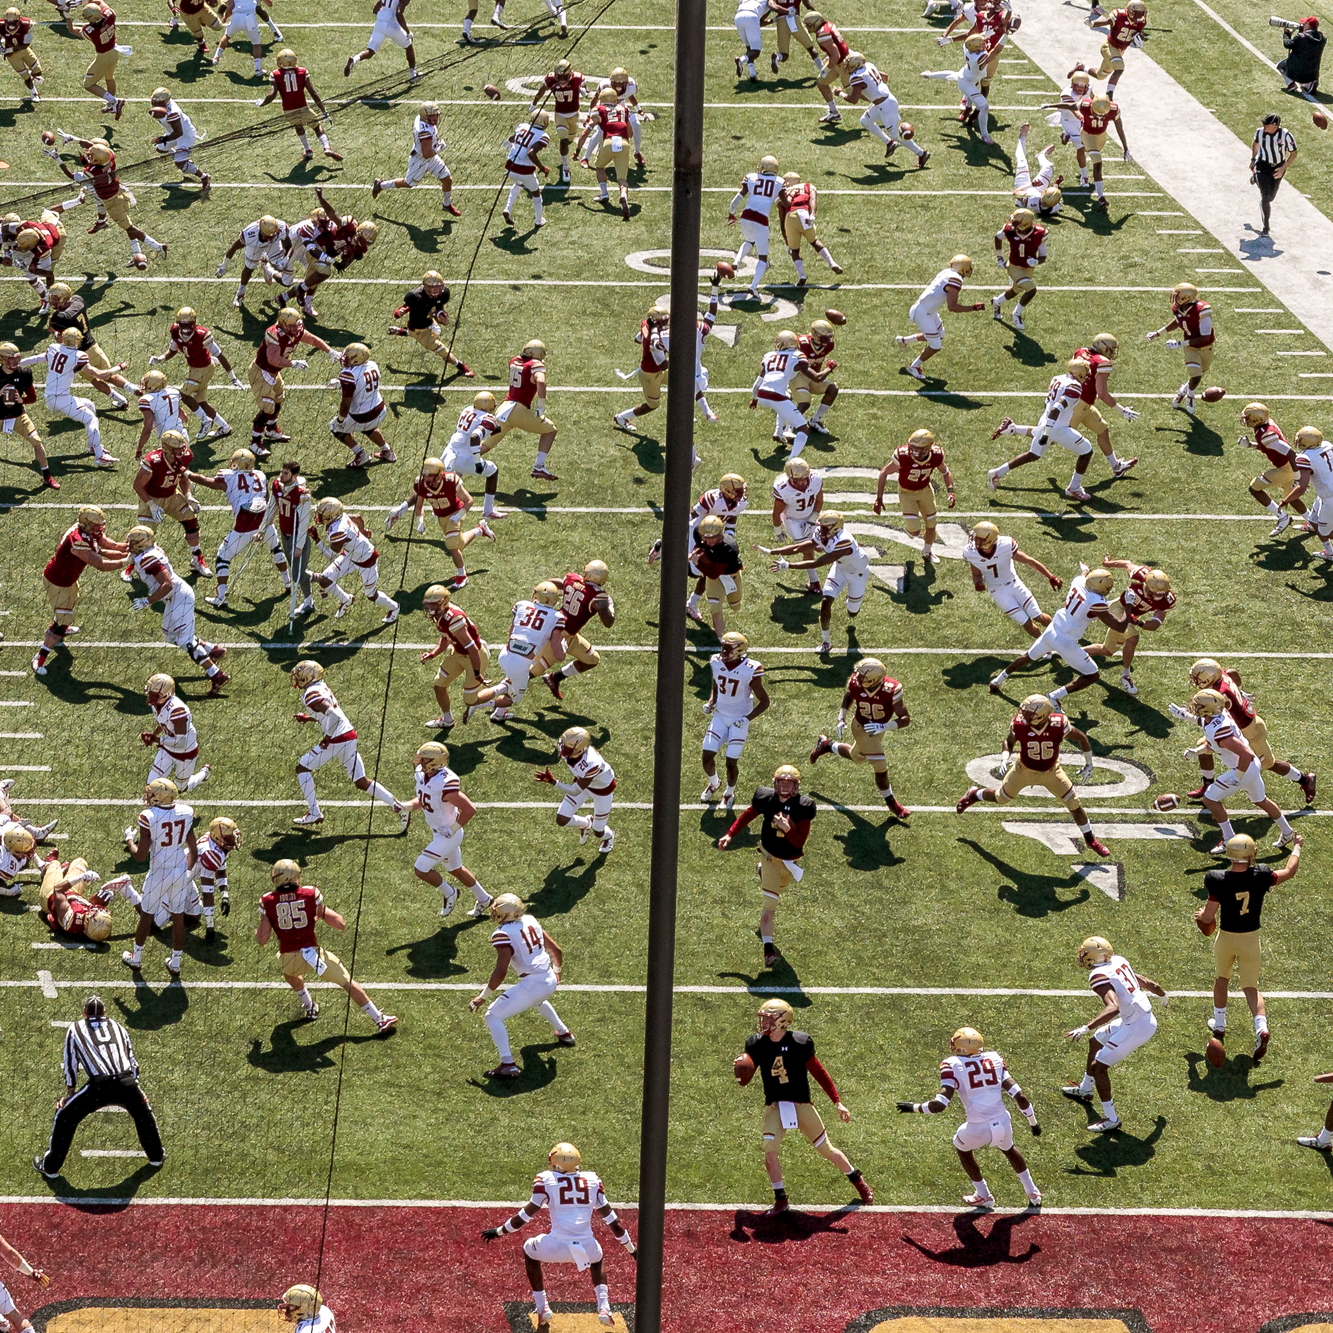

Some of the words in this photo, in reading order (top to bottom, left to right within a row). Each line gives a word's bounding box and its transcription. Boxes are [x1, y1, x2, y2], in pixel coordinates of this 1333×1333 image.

[284, 71, 297, 92] 11
[51, 352, 68, 374] 18
[238, 473, 263, 493] 43
[987, 564, 998, 578] 7
[520, 607, 548, 631] 36
[718, 675, 739, 697] 37
[1027, 741, 1054, 760] 26
[161, 819, 185, 847] 37
[276, 900, 308, 929] 85
[1236, 891, 1250, 915] 7
[520, 926, 542, 955] 14
[94, 1023, 112, 1043] U
[771, 1056, 789, 1084] 4
[965, 1059, 998, 1089] 29
[557, 1177, 589, 1204] 29
